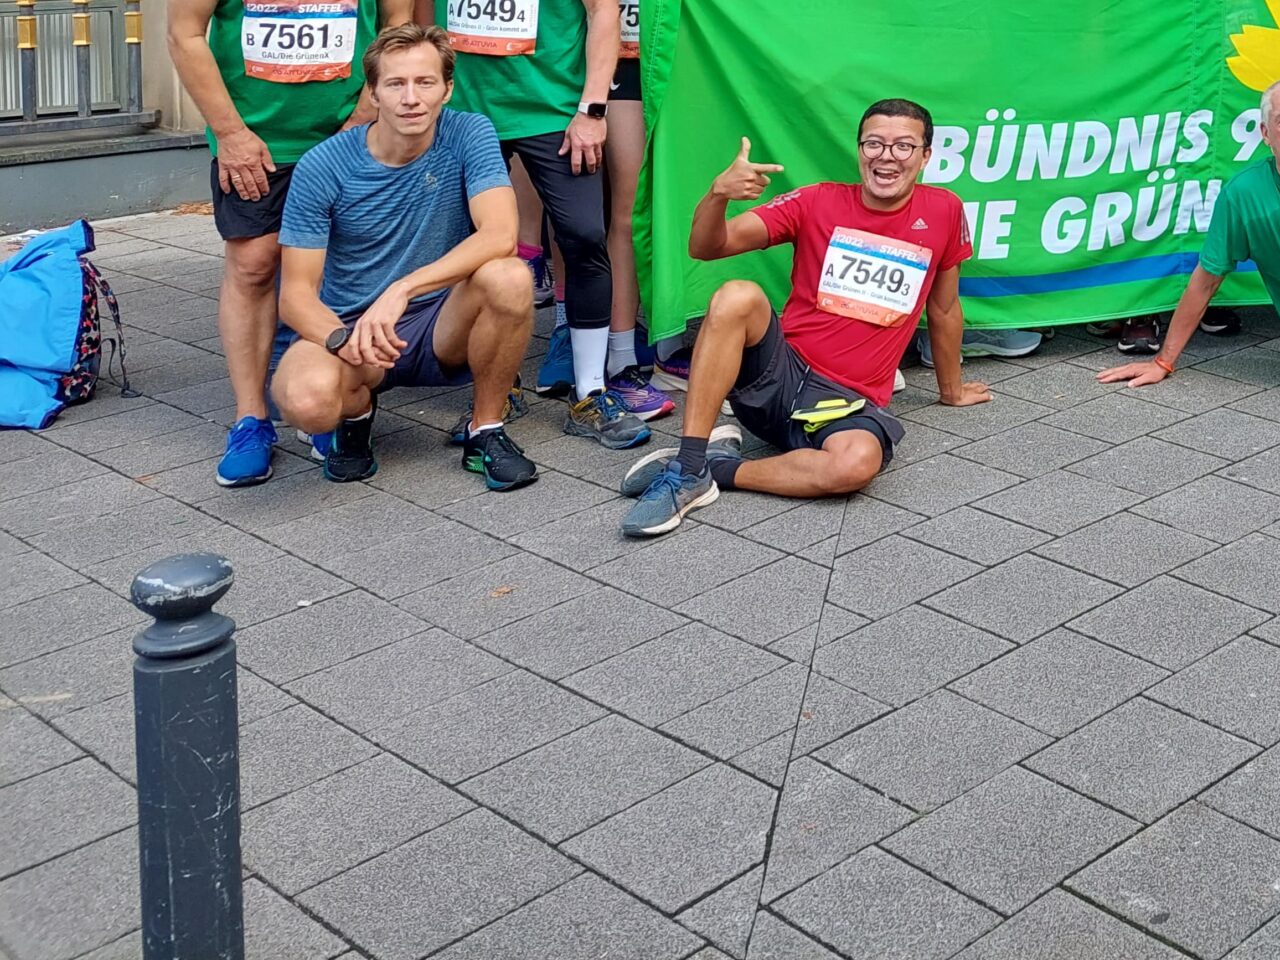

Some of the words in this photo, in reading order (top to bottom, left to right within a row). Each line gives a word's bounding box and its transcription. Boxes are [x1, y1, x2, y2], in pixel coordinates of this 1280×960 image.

[298, 4, 343, 13] STAFFEL
[449, 3, 454, 16] A
[517, 10, 525, 22] 4
[246, 33, 255, 46] B
[259, 23, 329, 49] 7561
[334, 35, 343, 48] 3
[922, 108, 1213, 183] BÜNDNIS
[1040, 169, 1222, 255] GRÜN
[880, 244, 919, 261] STAFFEL
[825, 264, 834, 277] A
[838, 254, 905, 293] 7549
[901, 283, 911, 296] 3
